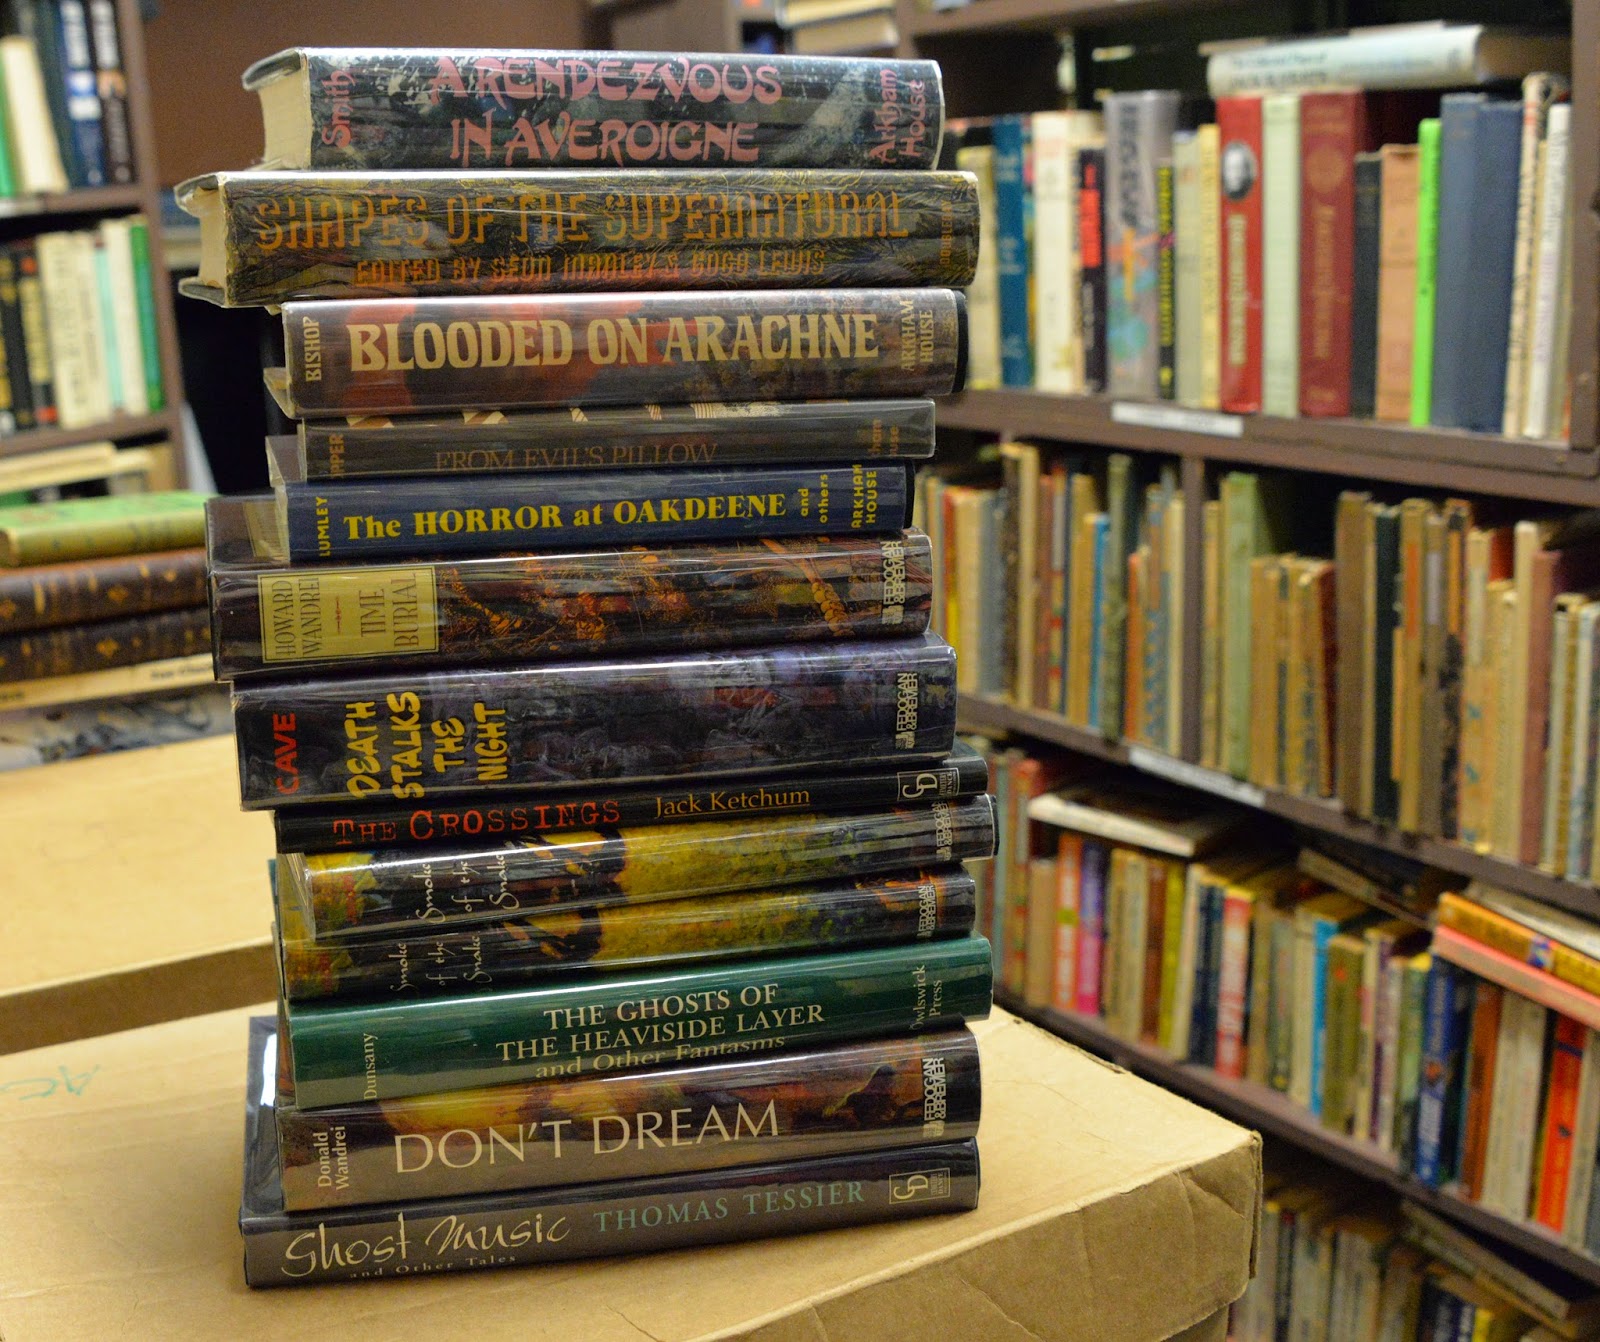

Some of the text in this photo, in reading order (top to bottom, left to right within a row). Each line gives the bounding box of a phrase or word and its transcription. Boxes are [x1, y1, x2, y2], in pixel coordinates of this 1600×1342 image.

[321, 69, 358, 149] Smith
[471, 56, 782, 109] RENDEZVOUS
[450, 107, 760, 168] IN AVEROIGNE
[867, 69, 898, 164] Arkham
[899, 80, 926, 157] House
[255, 189, 909, 252] SHAPES OF THE SUPERNATURAL
[354, 257, 441, 288] EDITED
[450, 256, 482, 284] BY
[757, 249, 826, 277] LEWIS
[303, 316, 322, 382] BISHOP
[346, 313, 880, 372] BLOODED ON ARACHNE
[898, 299, 915, 372] ARKHAM
[919, 309, 934, 364] HOUSE
[435, 450, 515, 472] FROM
[612, 442, 719, 467] PILLOW
[343, 493, 788, 541] The HORROR at OAKDEENE
[797, 488, 810, 517] and
[818, 472, 829, 524] others
[851, 464, 863, 529] ARKHAM
[866, 471, 877, 524] HOUSE
[316, 495, 331, 557] LUMLEY
[880, 541, 895, 605] FEDOGAN
[271, 580, 297, 656] HOWARD
[358, 588, 387, 638] TIME
[391, 572, 420, 648] BURIAL
[896, 673, 907, 731] FEDOGAN
[273, 712, 299, 795] CAVE
[344, 701, 381, 798] DEATH
[386, 691, 425, 799] STALKS
[431, 717, 466, 773] THE
[473, 702, 509, 781] NIGHT
[332, 800, 621, 846] THE CROSSINGS
[655, 788, 811, 820] Jack Ketchum
[413, 863, 447, 925] Smoke
[451, 860, 485, 913] of the
[487, 854, 520, 911] Snake
[917, 885, 927, 931] FEDOGAN
[388, 943, 416, 992] Smoke
[426, 941, 457, 986] of the
[463, 935, 493, 984] Snake
[543, 983, 780, 1032] THE GHOSTS OF
[908, 965, 927, 1031] Owlswick
[929, 979, 943, 1018] Press
[495, 1003, 826, 1062] THE HEAVISIDE LAYER
[535, 1033, 787, 1079] and Other Fantasms
[363, 1032, 379, 1100] Dunsany
[922, 1058, 934, 1121] FEDOGAN
[313, 1131, 332, 1188] Donald
[333, 1124, 350, 1191] Wandrei
[394, 1099, 780, 1175] DON'T DREAM
[593, 1181, 866, 1233] THOMAS TESSIER
[281, 1212, 571, 1278] Ghost Music
[349, 1253, 518, 1279] and Other Tales
